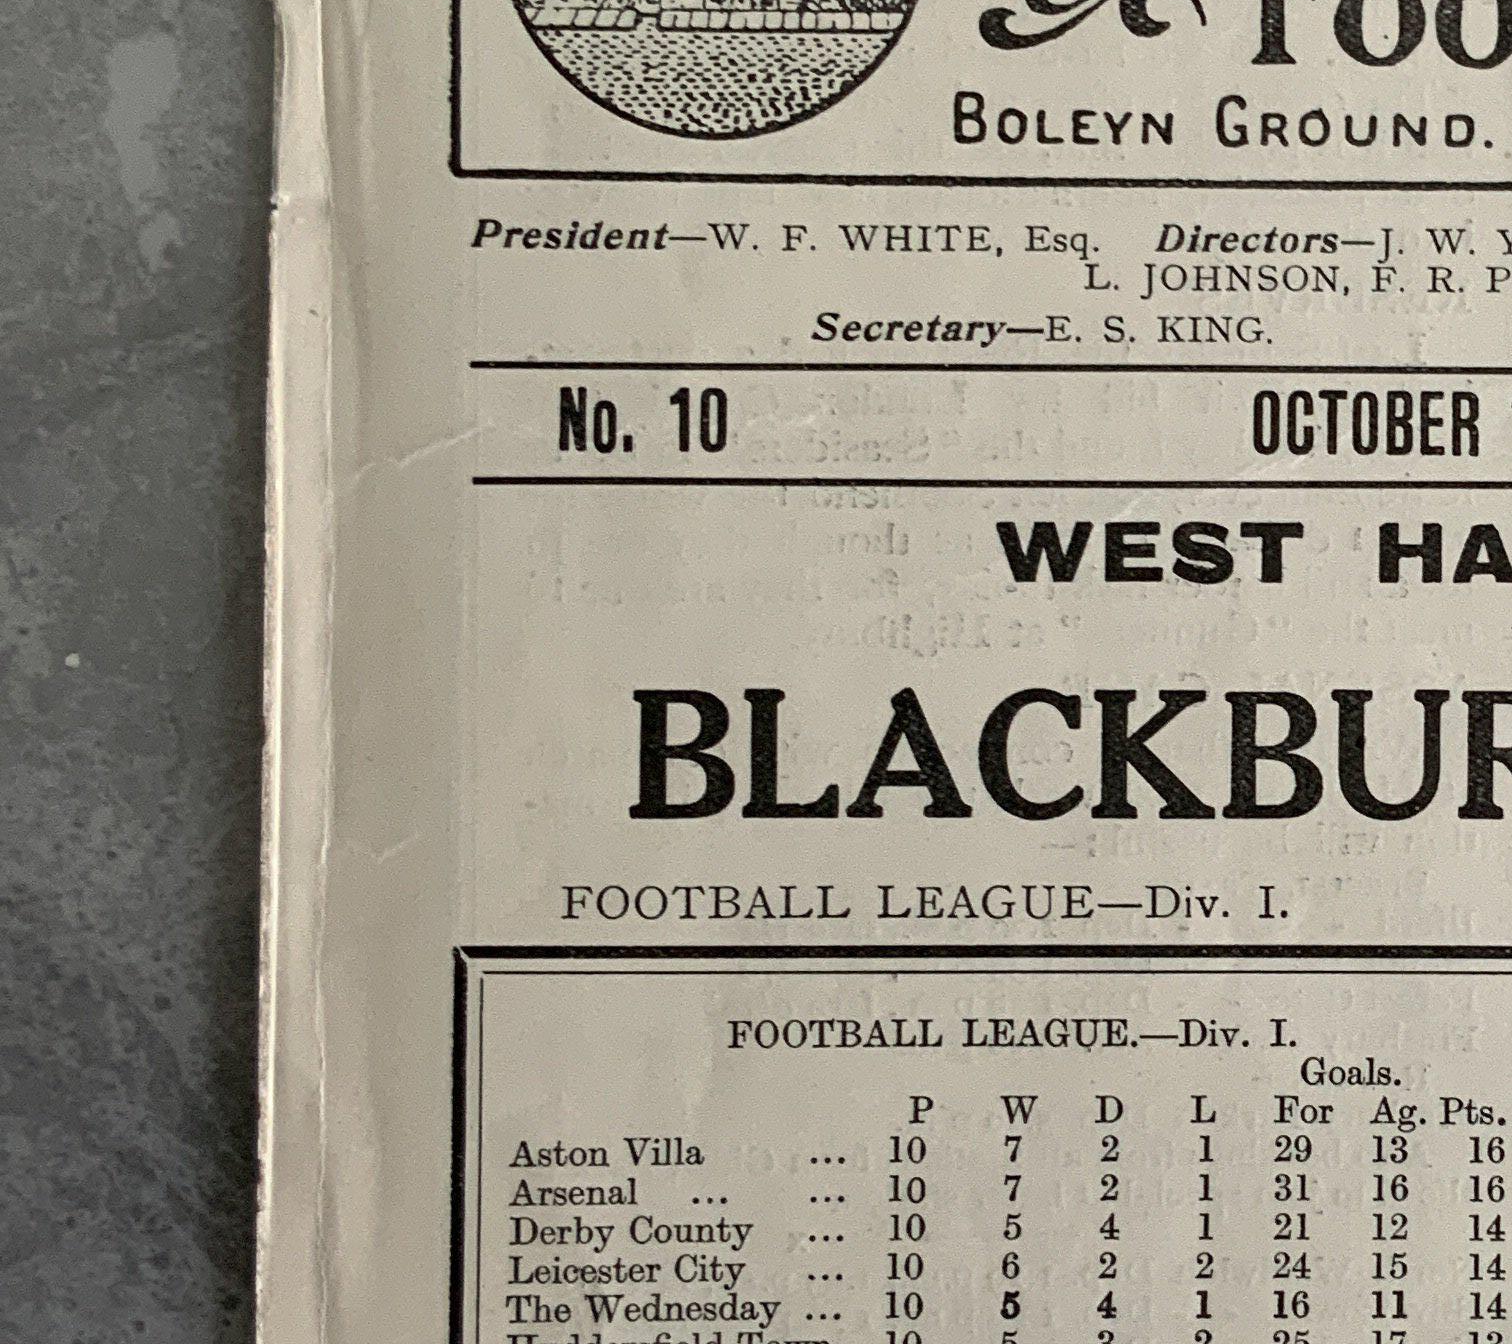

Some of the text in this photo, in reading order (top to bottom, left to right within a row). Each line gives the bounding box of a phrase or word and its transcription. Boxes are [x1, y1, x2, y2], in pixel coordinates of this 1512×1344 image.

[953, 90, 1174, 146] BOLEYN
[781, 224, 816, 252] F.
[838, 224, 1003, 258] WHITE,
[1024, 225, 1100, 261] Esq.
[1425, 228, 1475, 256] W.
[1084, 263, 1120, 291] L.
[1139, 263, 1350, 300] JOHNSON,
[1371, 265, 1405, 293] F.
[1426, 266, 1464, 294] R.
[1103, 315, 1136, 344] S.
[1156, 315, 1273, 345] KING.
[558, 386, 728, 455] No. 10
[1252, 389, 1480, 458] OCTOBER
[995, 520, 1305, 586] WEST
[560, 884, 852, 921] FOOTBALL
[1258, 885, 1289, 919] I.
[727, 1017, 944, 1050] FOOTBALL
[1269, 1018, 1297, 1048] I.
[1300, 1056, 1402, 1087] Goals.
[908, 1094, 1507, 1134] P W D L For Ag. Pts.
[508, 1134, 1506, 1168] Aston Villa 10 7 2 1 29 13 16
